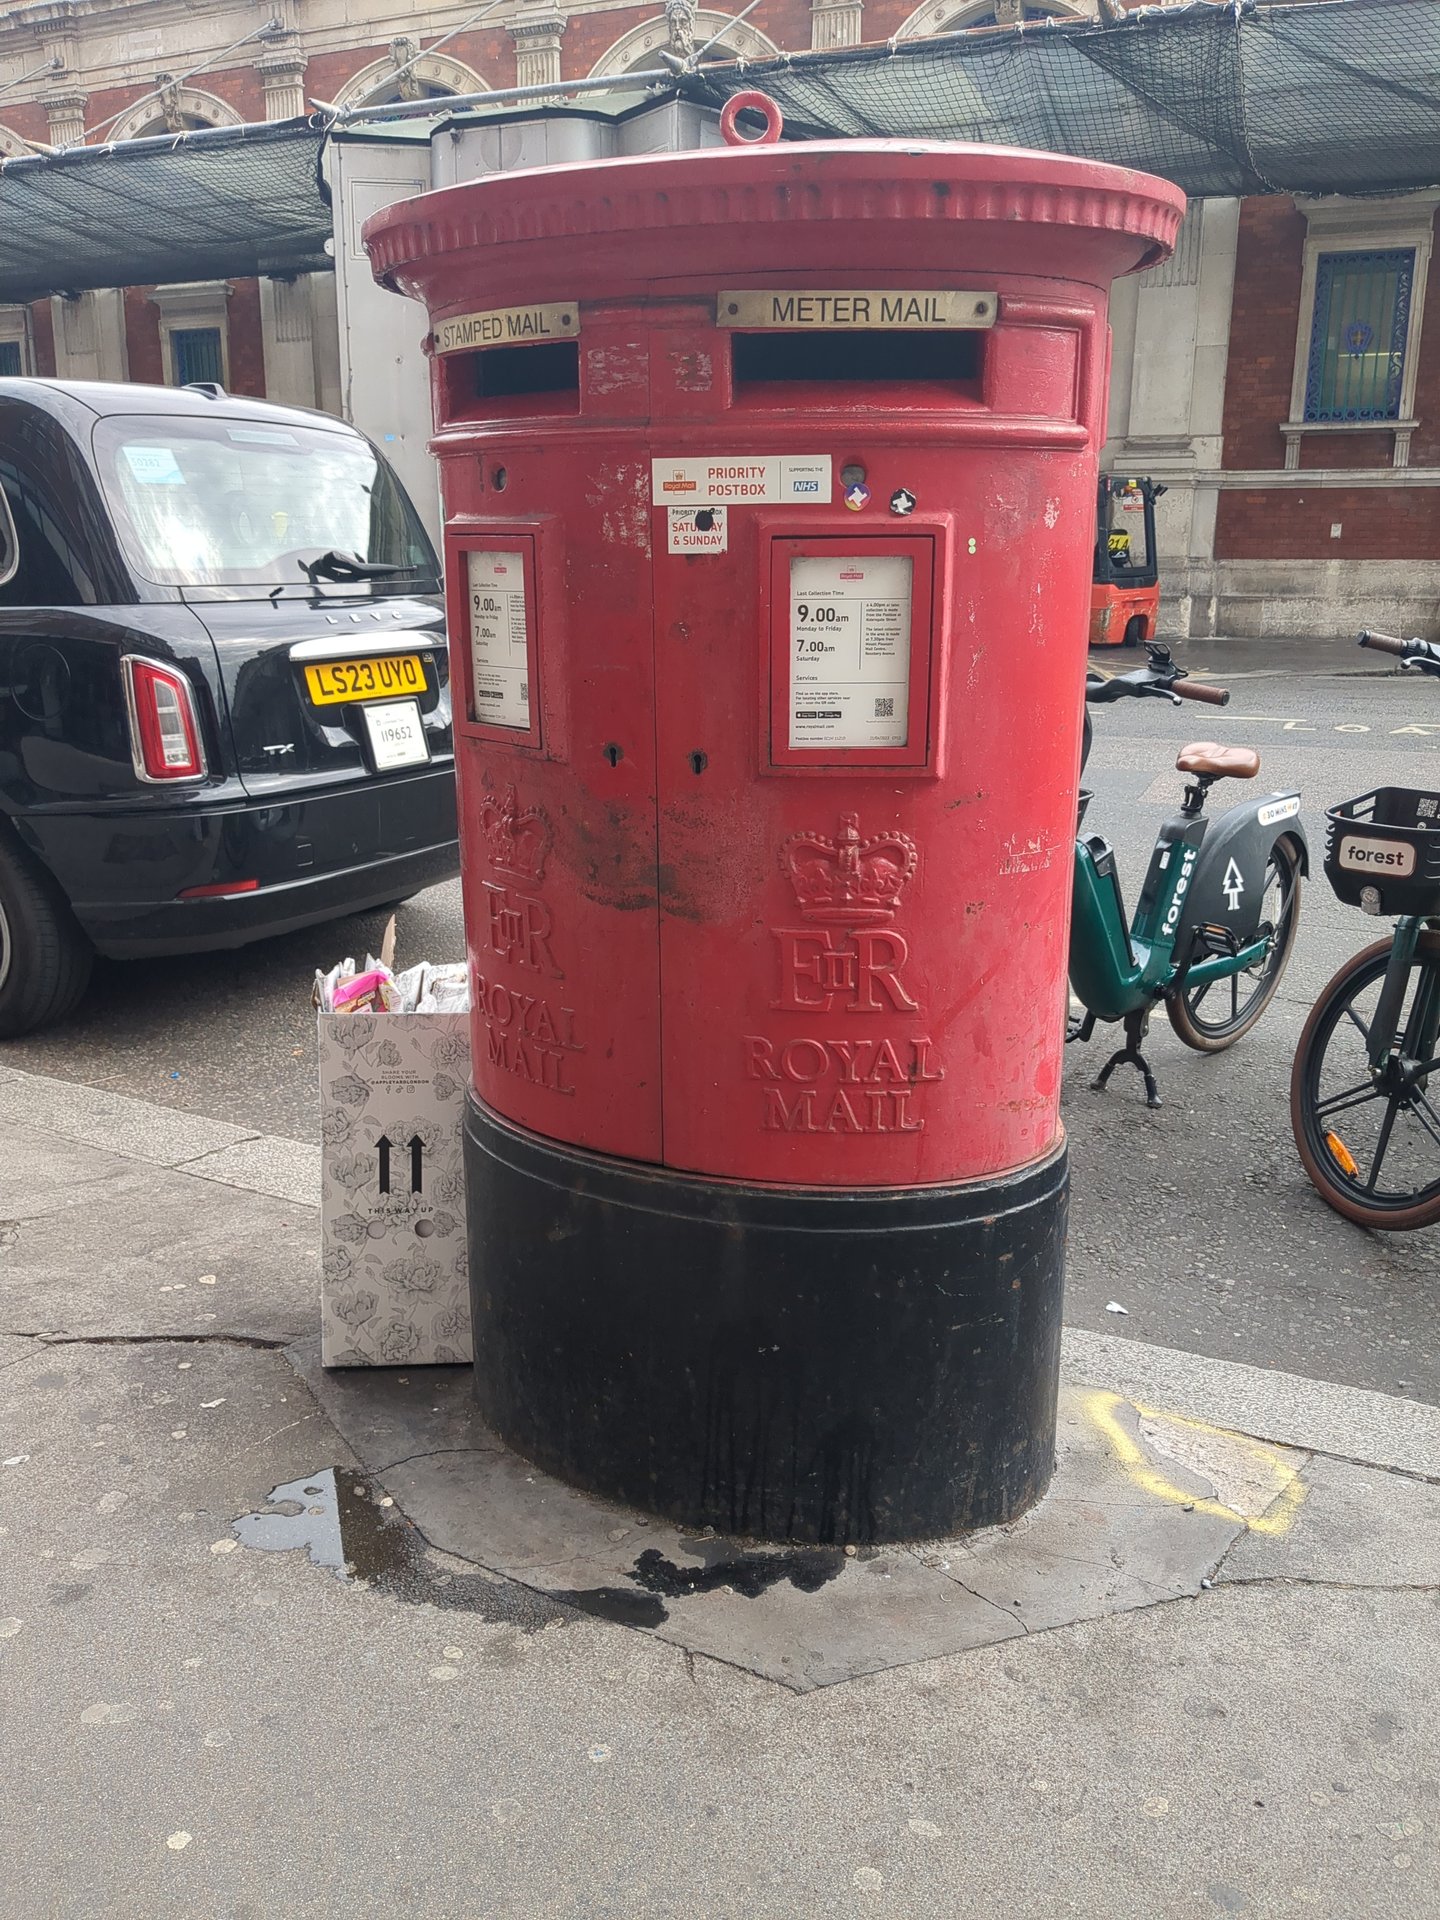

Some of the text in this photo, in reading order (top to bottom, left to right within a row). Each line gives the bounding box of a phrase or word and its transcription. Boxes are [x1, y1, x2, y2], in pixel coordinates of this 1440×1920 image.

[773, 297, 946, 322] METER MAIL
[444, 312, 550, 347] STAMPED MAIL
[708, 467, 765, 479] PRIORITY
[664, 482, 681, 490] Royal
[708, 484, 765, 496] POSTBOX
[794, 482, 818, 491] NHS
[672, 522, 723, 532] SATUAY
[673, 535, 723, 545] & SUNDAY
[474, 595, 502, 611] 9.00am
[325, 609, 402, 625] LEVC
[797, 604, 849, 622] 9.00am
[475, 626, 496, 638] 7.00am
[797, 639, 835, 652] 7.00am
[314, 659, 417, 696] LS23 UYO
[381, 725, 412, 742] 119652
[262, 744, 295, 755] TX
[1348, 846, 1404, 866] forest
[1162, 849, 1196, 936] forest
[476, 972, 587, 1051] ROYAL
[485, 1022, 576, 1097] MAIL
[744, 1035, 945, 1084] ROYAL
[764, 1088, 924, 1133] MAIL
